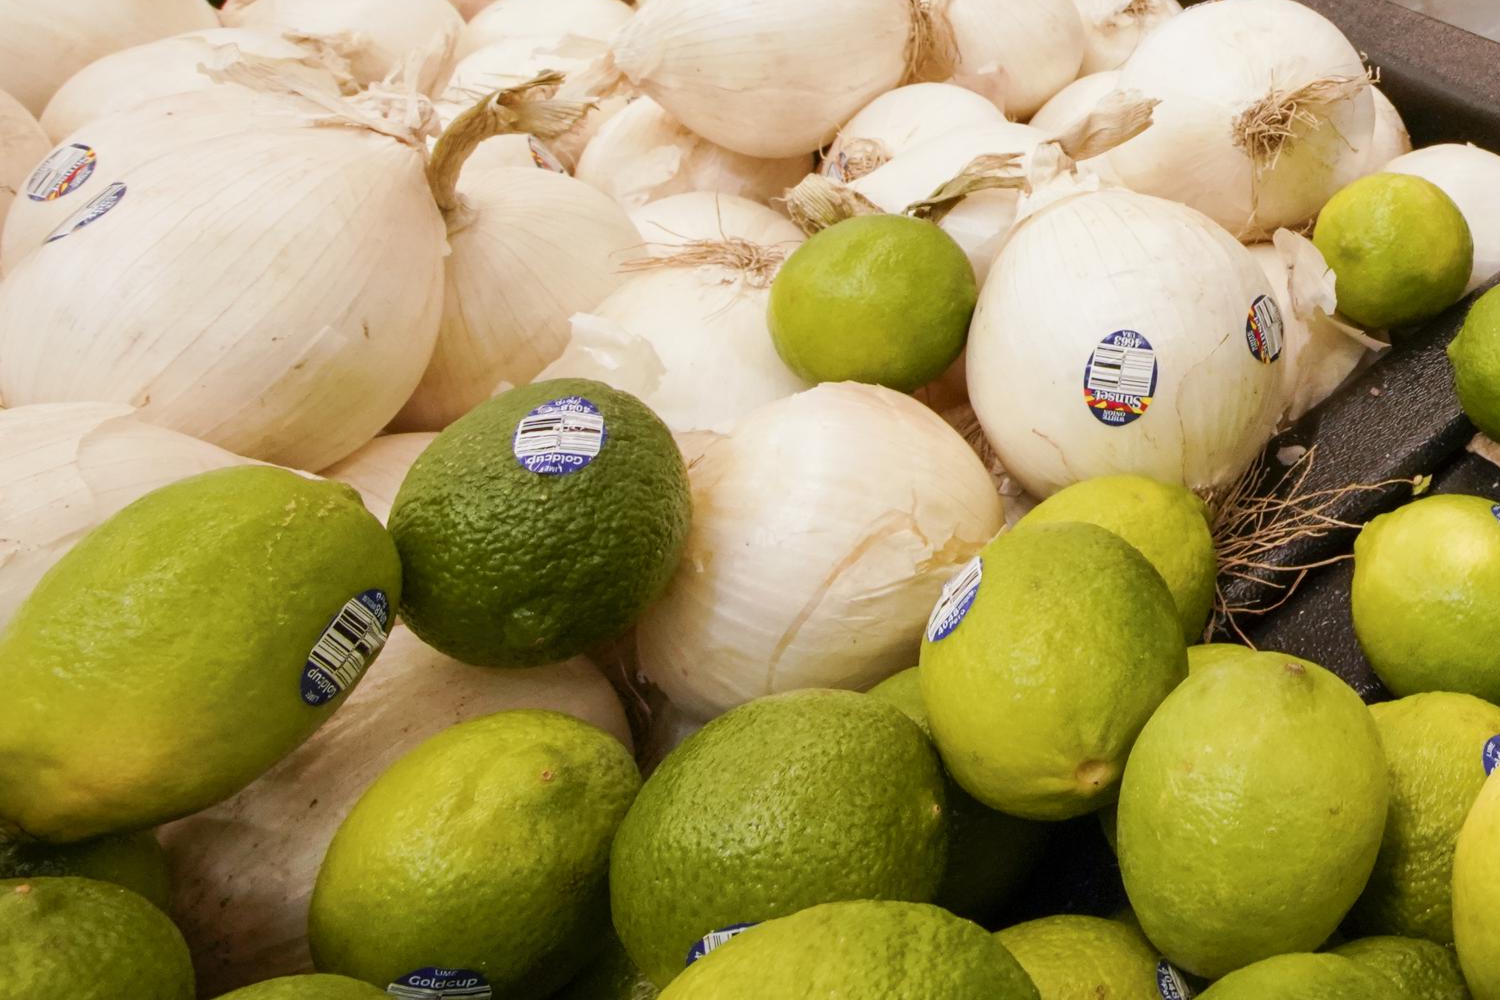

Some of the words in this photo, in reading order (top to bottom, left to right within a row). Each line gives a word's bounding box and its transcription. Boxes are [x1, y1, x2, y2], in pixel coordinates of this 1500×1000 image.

[1113, 336, 1142, 348] 4663
[1094, 390, 1142, 409] Sunset
[525, 453, 584, 466] Goldcup
[937, 606, 961, 636] 4048
[434, 968, 458, 977] LIME
[408, 975, 478, 989] Goldcup
